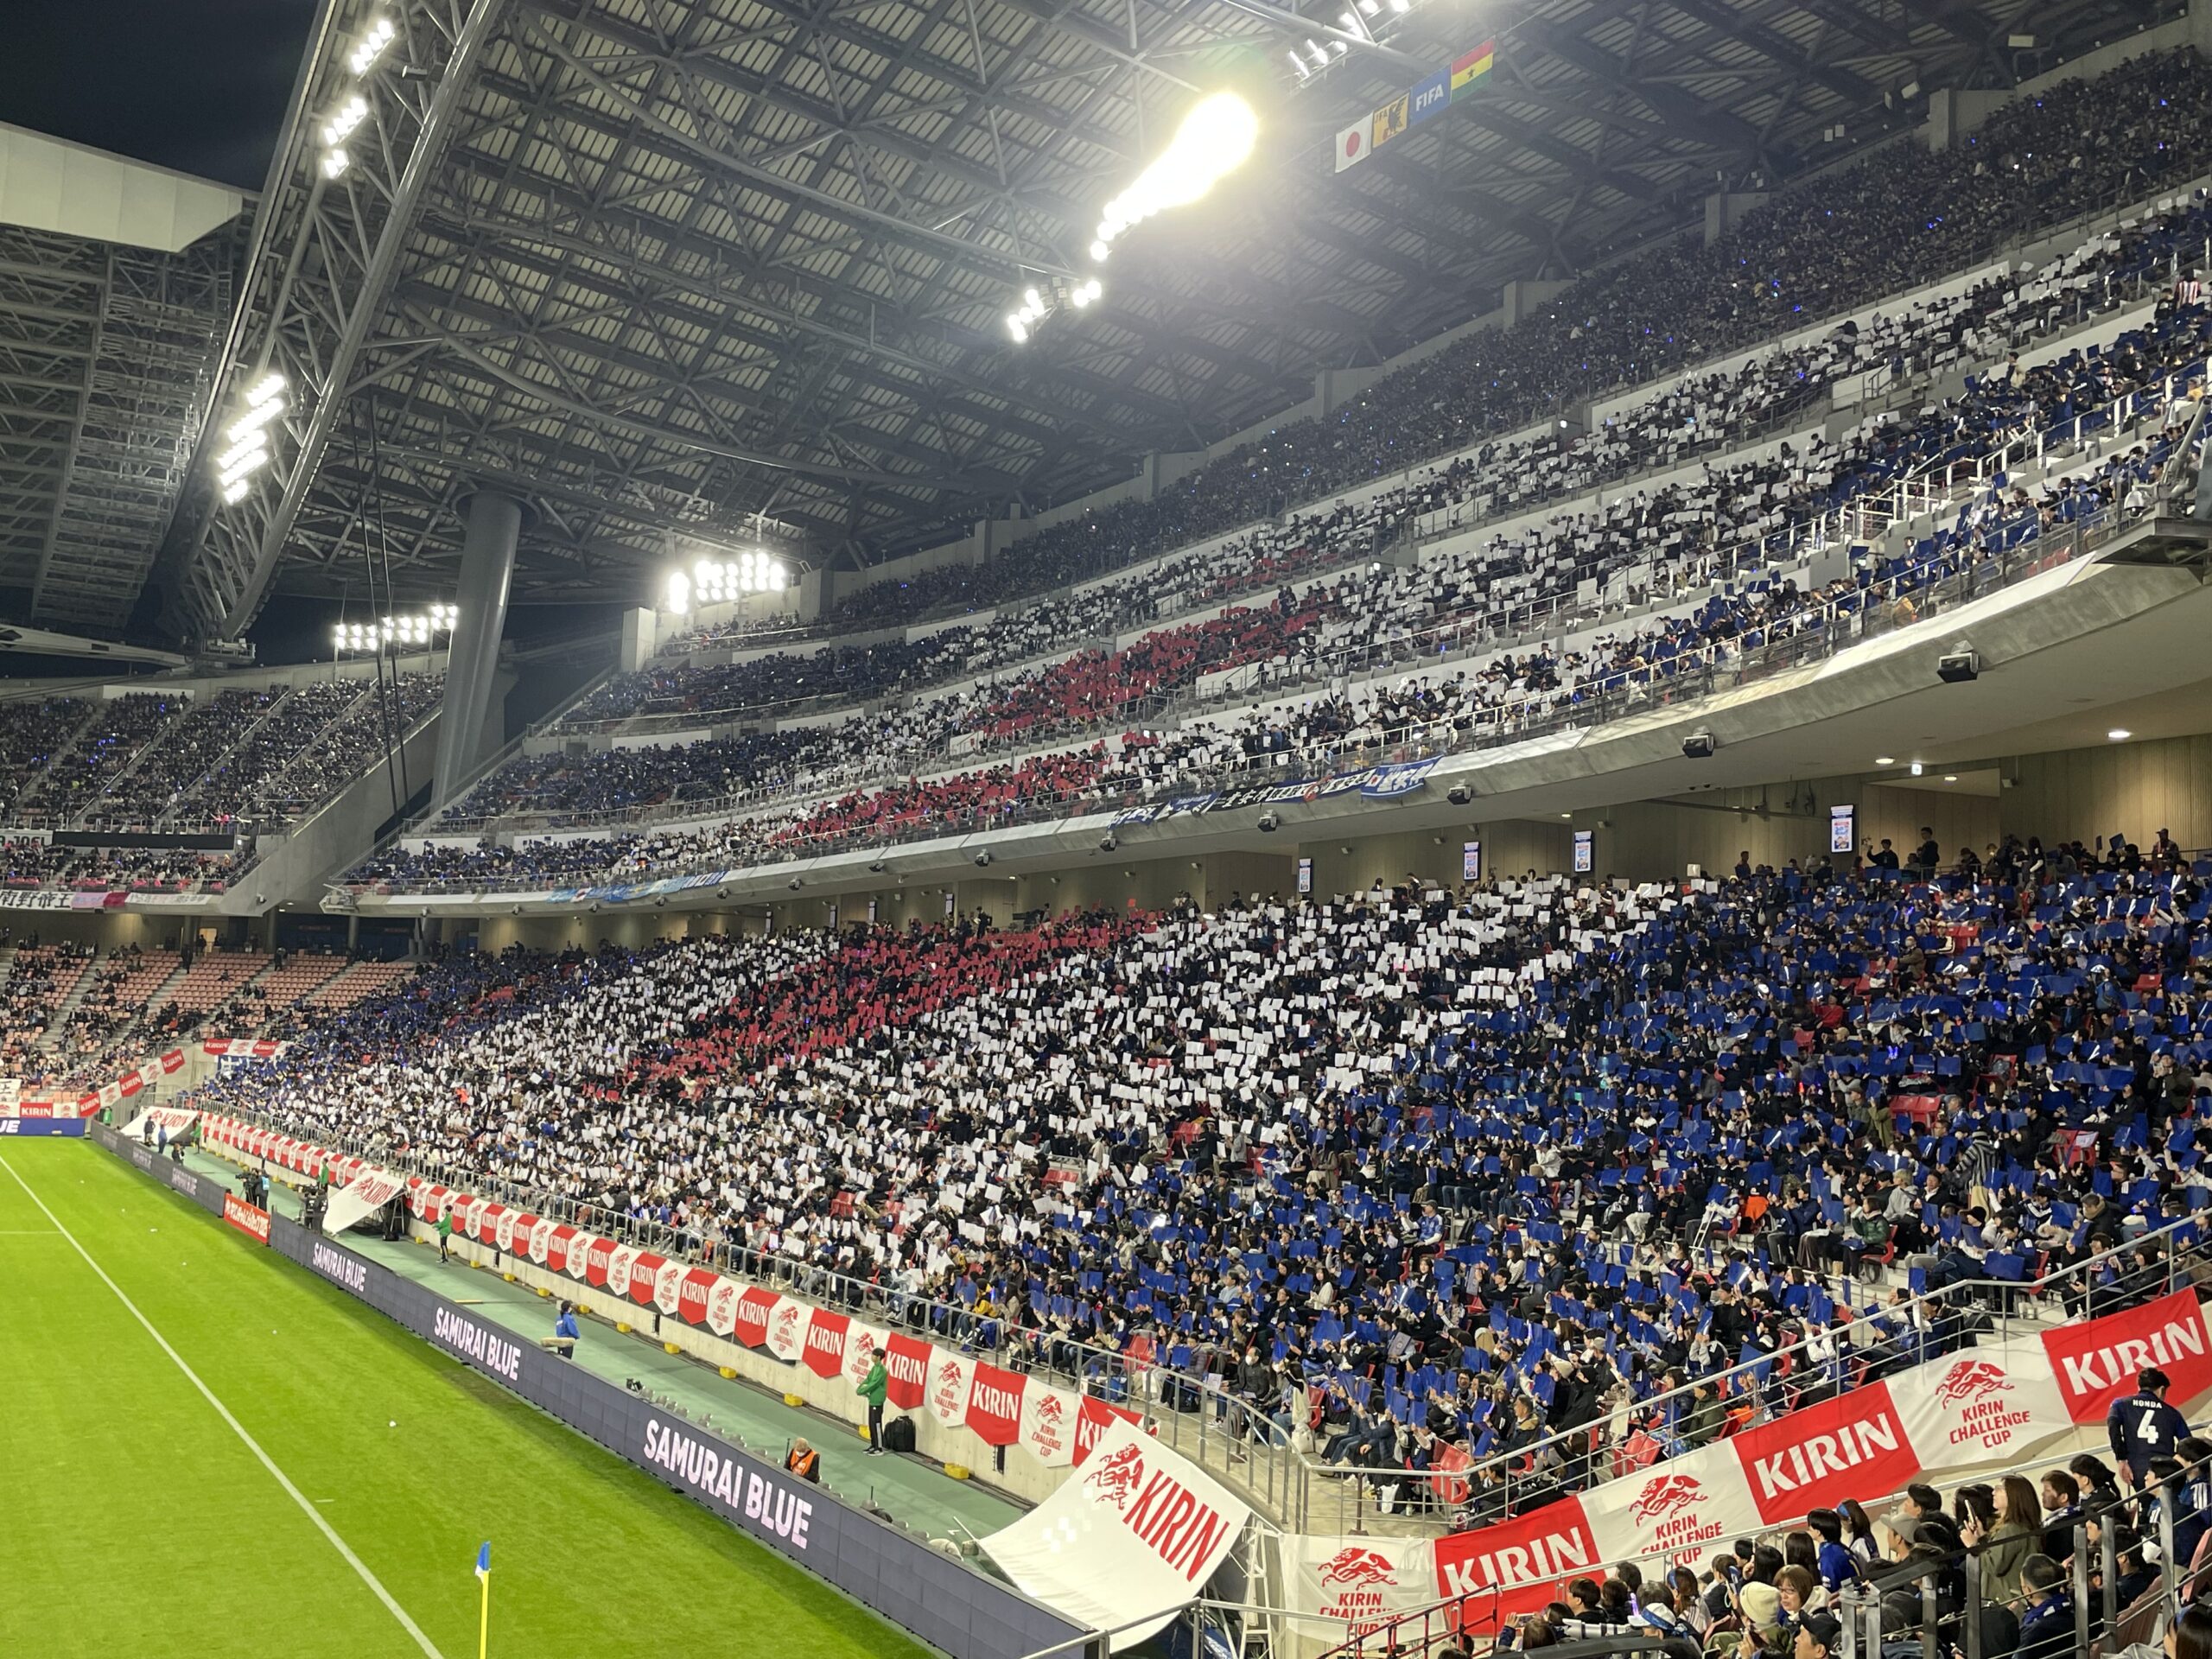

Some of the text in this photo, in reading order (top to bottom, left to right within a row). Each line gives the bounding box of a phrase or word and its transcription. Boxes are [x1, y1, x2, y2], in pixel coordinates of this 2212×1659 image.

[1414, 83, 1444, 111] FIFA
[120, 1076, 141, 1091] KIRIN
[21, 1107, 52, 1116] KIRIN
[80, 1096, 100, 1112] KIRIN
[549, 1235, 569, 1255] KIRIN
[312, 1242, 367, 1293] SAMURAI BLUE
[588, 1248, 610, 1269] KIRIN
[632, 1262, 657, 1286] KIRIN
[681, 1279, 709, 1306] KIRIN
[738, 1300, 769, 1327] KIRIN
[434, 1306, 522, 1381] SAMURAI BLUE
[807, 1324, 844, 1357] KIRIN
[2062, 1316, 2205, 1396] KIRIN
[886, 1351, 926, 1386] KIRIN
[935, 1395, 959, 1412] CHALLENGE
[940, 1387, 955, 1401] KIRIN
[972, 1380, 1020, 1421] KIRIN
[2133, 1399, 2163, 1409] HONDA
[940, 1408, 950, 1418] CUP
[1961, 1399, 2004, 1423] KIRIN
[1039, 1423, 1057, 1438] KIRIN
[1949, 1410, 2031, 1446] CHALLENGE
[2137, 1409, 2159, 1445] 4
[1031, 1431, 1062, 1452] CHALLENGE
[1982, 1430, 2011, 1449] CUP
[1039, 1446, 1052, 1458] CUP
[1753, 1412, 1900, 1500] KIRIN
[643, 1419, 812, 1550] SAMURAI BLUE
[1122, 1468, 1230, 1583] KIRIN
[1656, 1514, 1698, 1541] KIRIN
[1443, 1526, 1590, 1597] KIRIN
[1674, 1547, 1702, 1567] CUP
[1338, 1592, 1382, 1606] KIRIN
